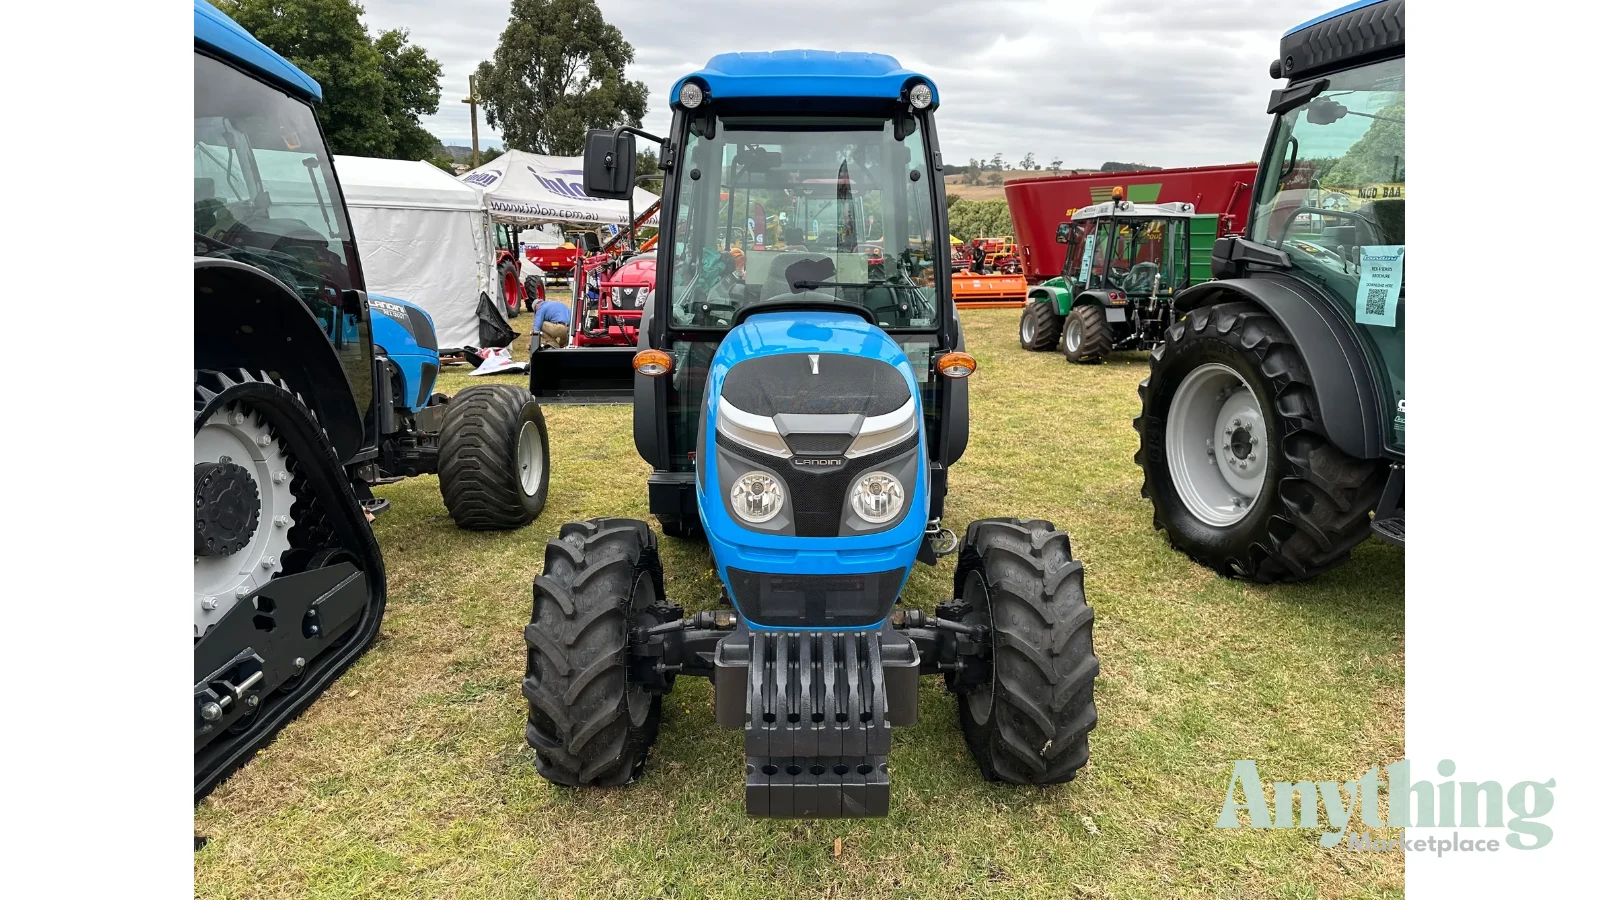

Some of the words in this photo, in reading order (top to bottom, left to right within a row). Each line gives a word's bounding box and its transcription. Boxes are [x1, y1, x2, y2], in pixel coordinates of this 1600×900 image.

[527, 166, 586, 197] inlo
[1383, 186, 1401, 198] BAA
[491, 201, 599, 221] www.inlon.com.au
